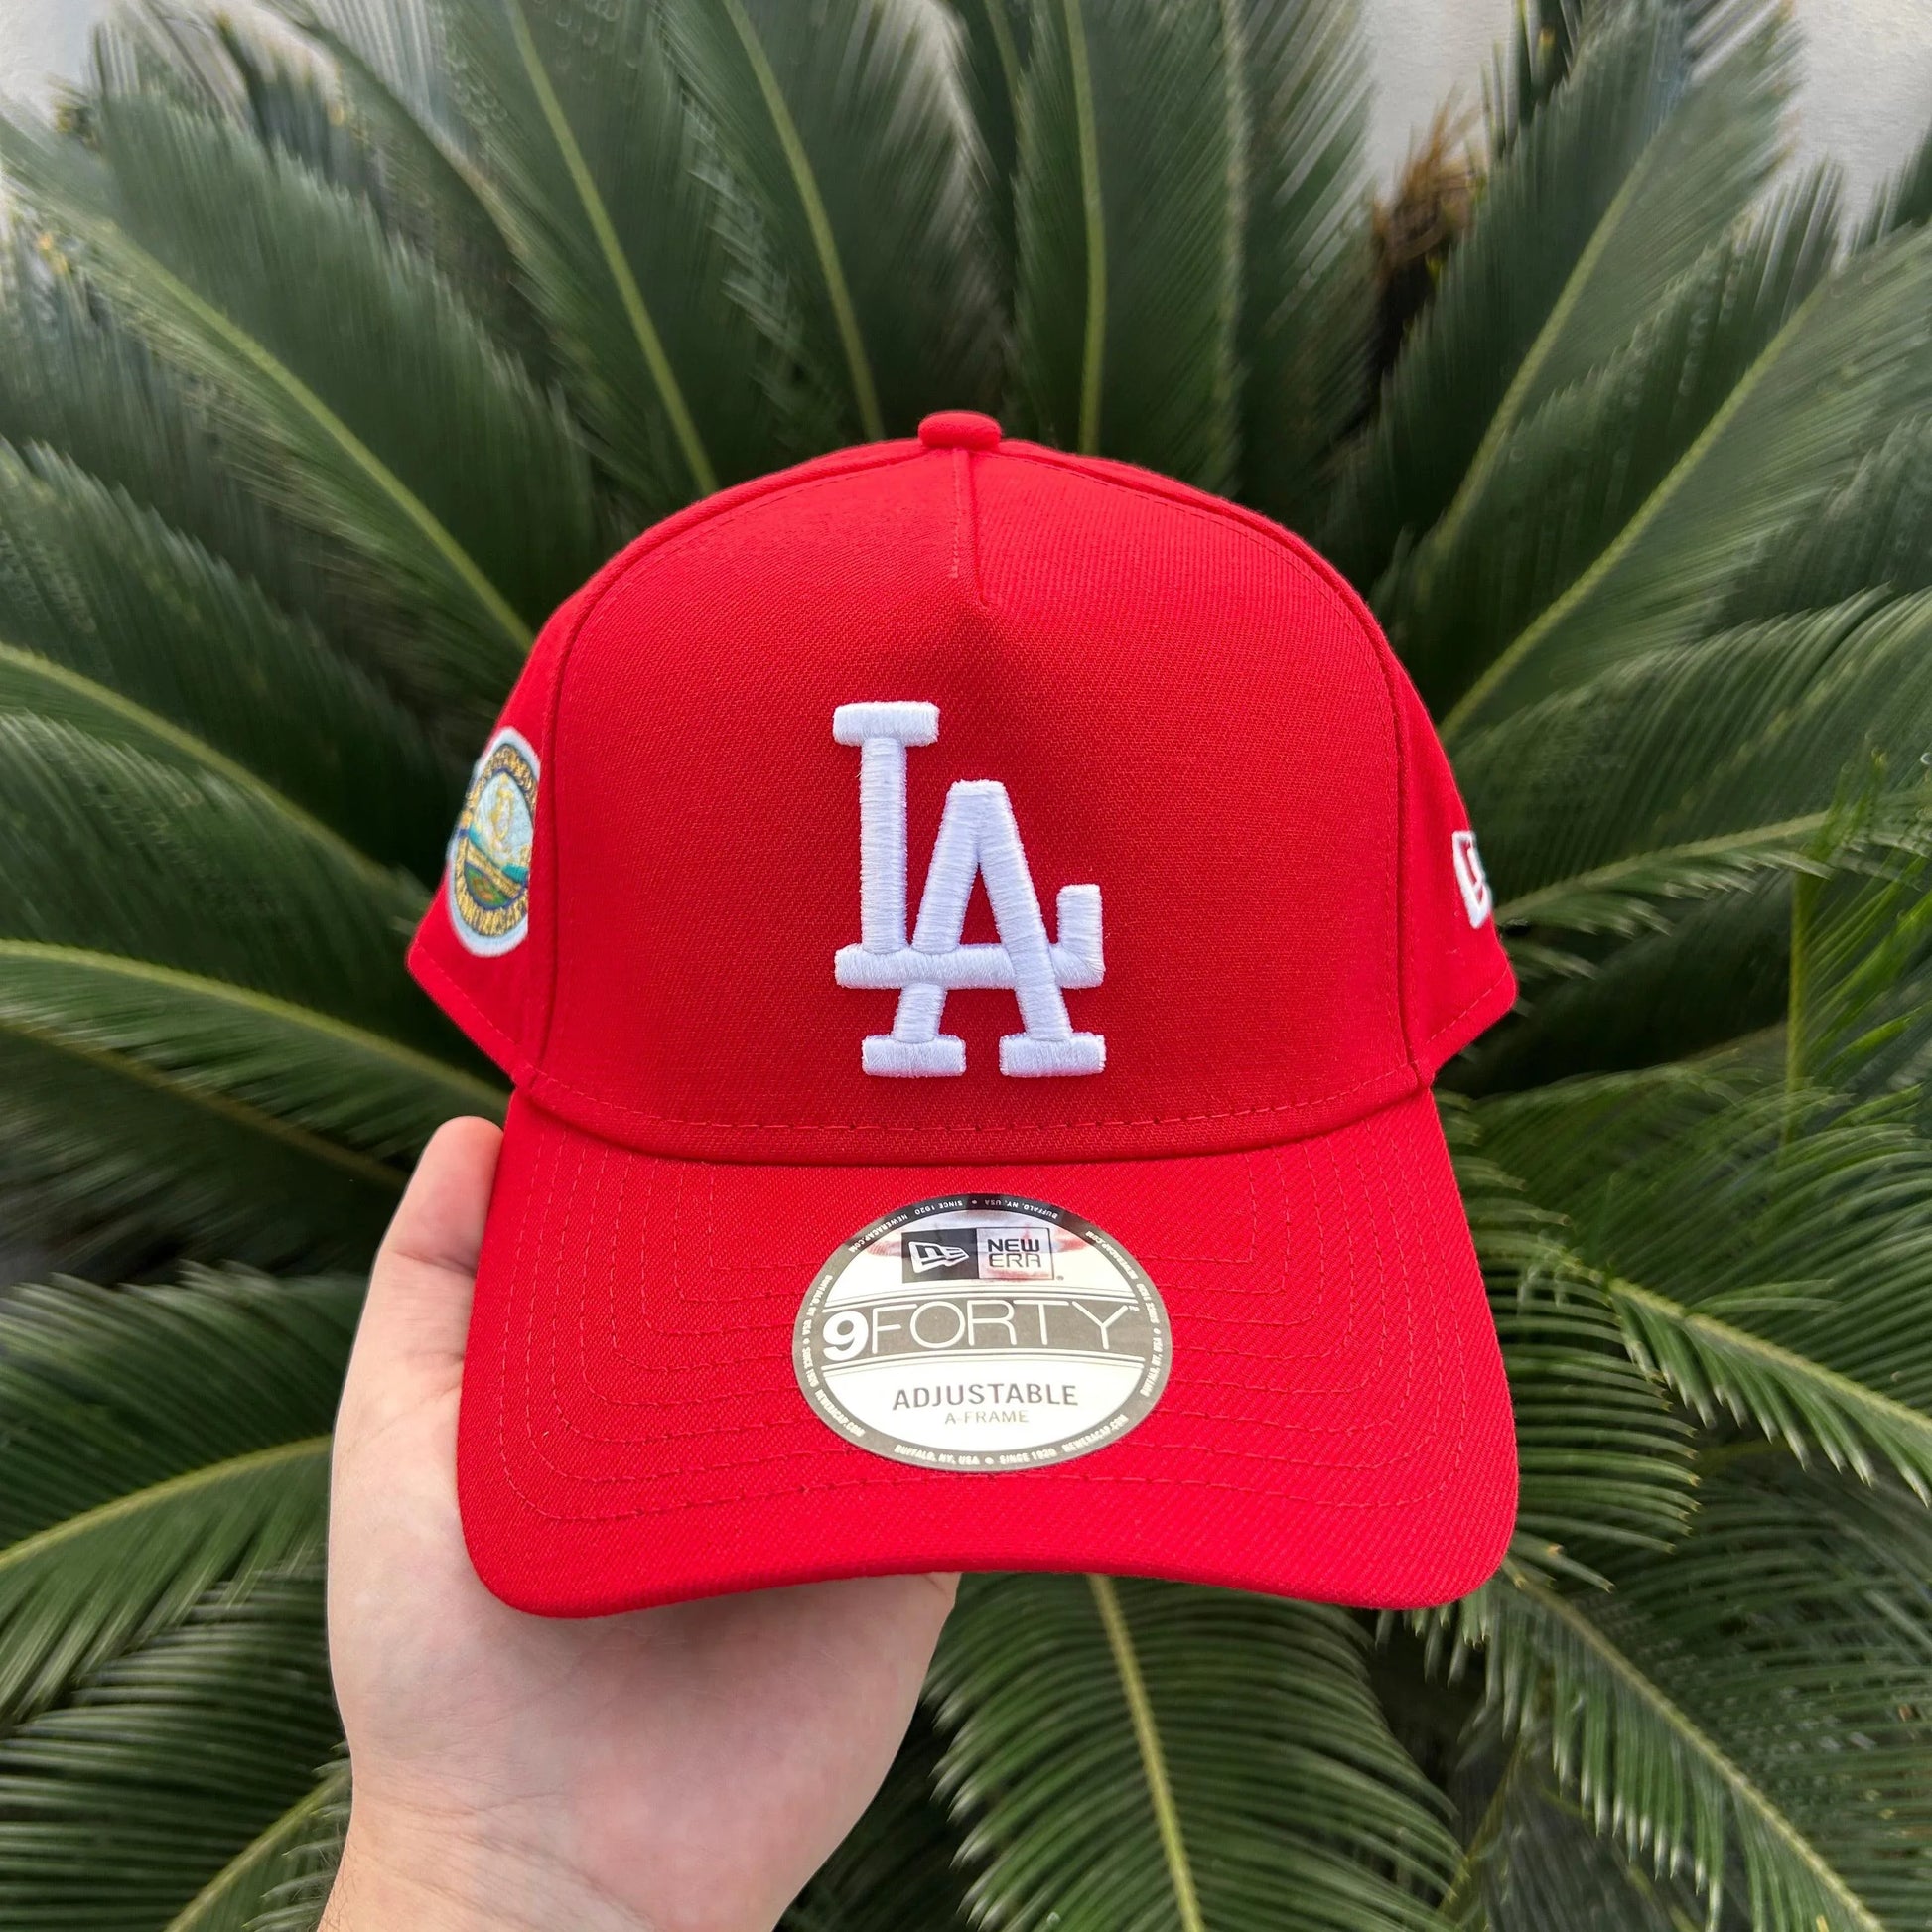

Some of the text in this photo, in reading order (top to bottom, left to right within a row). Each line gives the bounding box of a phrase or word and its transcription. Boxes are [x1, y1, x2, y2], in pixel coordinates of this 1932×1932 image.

[833, 700, 1107, 1078] LA
[914, 1199, 963, 1215] SINCE 1920
[987, 1238, 1040, 1253] NEW
[988, 1252, 1042, 1268] ERA
[892, 1383, 1079, 1411] ADJUSTABLE
[944, 1409, 1030, 1425] A-FRAME
